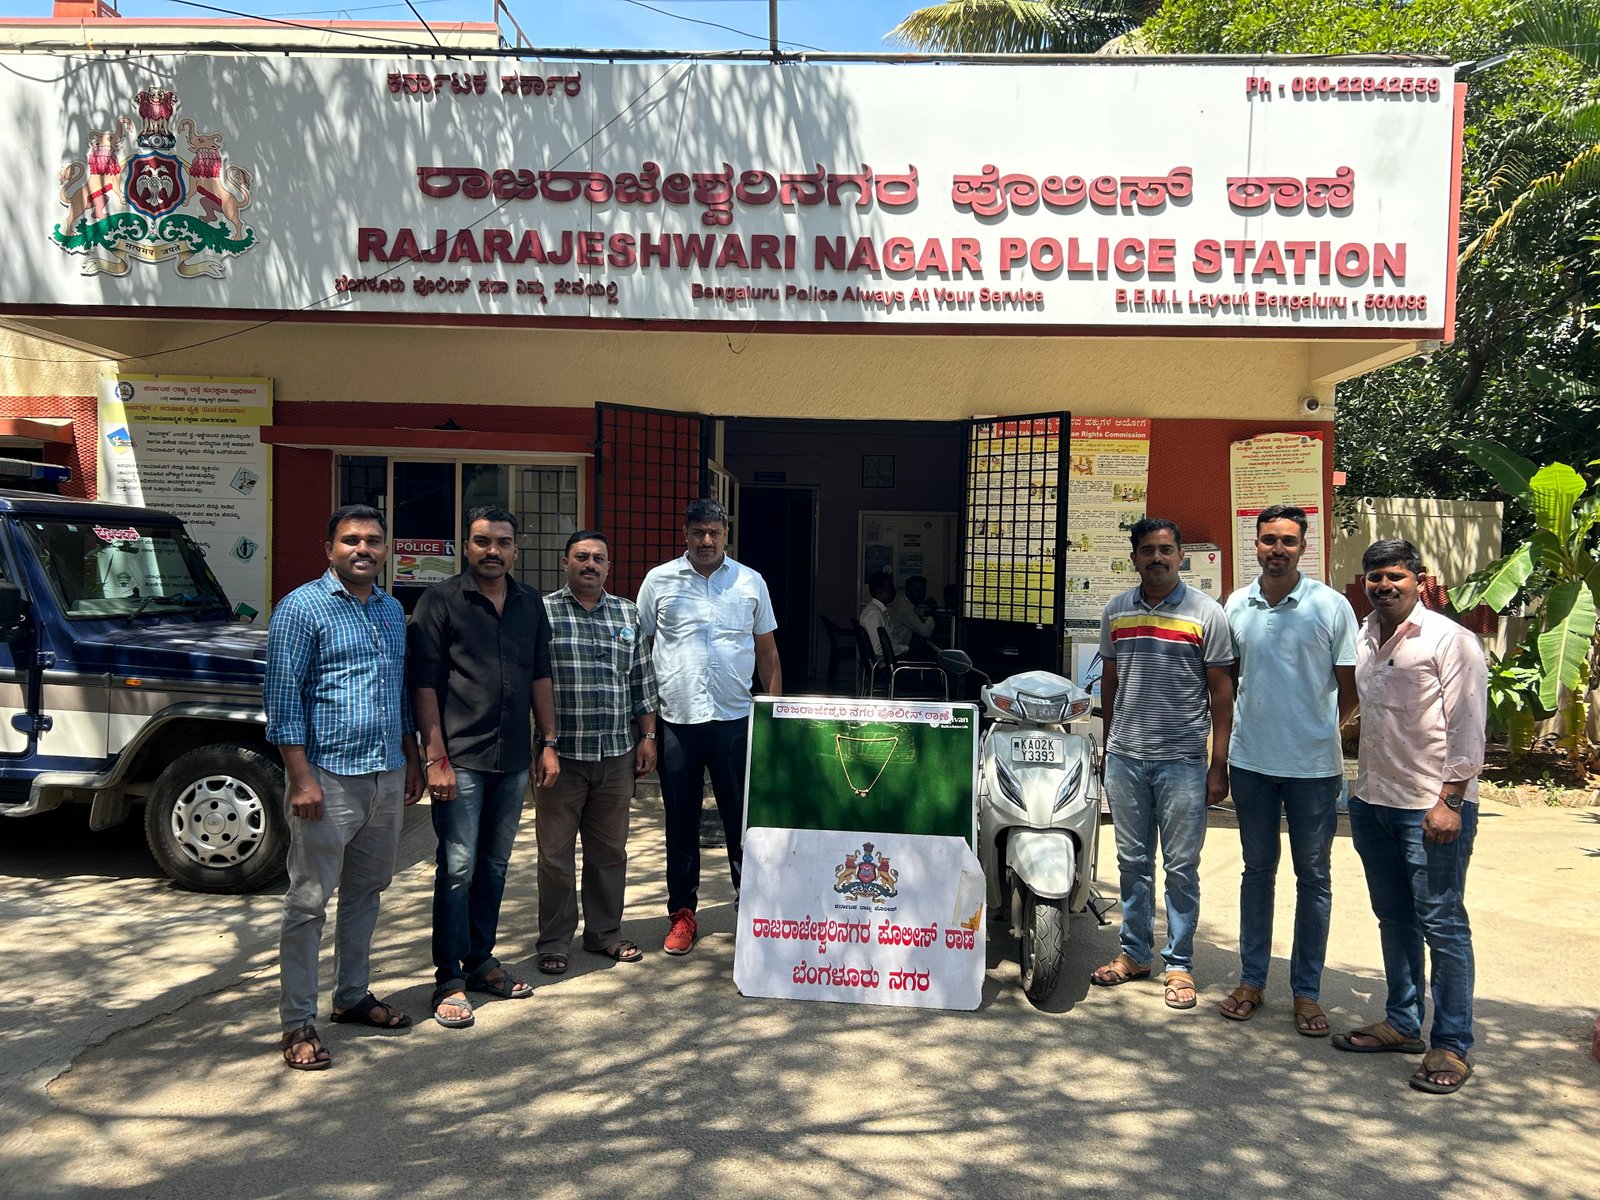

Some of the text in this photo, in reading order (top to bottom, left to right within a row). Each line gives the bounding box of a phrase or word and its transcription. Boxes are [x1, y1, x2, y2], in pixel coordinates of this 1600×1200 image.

[387, 68, 581, 98] ಕರ್ನಾಟಕ ಸರ್ಕಾರ
[1246, 77, 1271, 93] Ph
[1292, 76, 1440, 94] 080-22942559
[416, 162, 1355, 226] ರಾಜರಾಜೇಶ್ವರಿನಗರ ಪೊಲೀಸ್ ಠಾಣೆ
[125, 243, 180, 255] सत्यमेव जयते
[358, 227, 1407, 281] RAJARAJESHWARI NAGAR POLICE STATION
[335, 275, 405, 295] ಬೆಂಗಳೂರು
[478, 278, 509, 295] ಸದಾ
[516, 278, 548, 304] ನಿಮ್ಮ
[555, 278, 619, 305] ಸೇವೆಯಲ್ಲಿ
[691, 283, 1043, 306] Bengaluru Police Always At Your Service
[1188, 290, 1249, 309] Layout
[1255, 291, 1347, 310] Bengaluru
[1364, 294, 1427, 310] 560098
[1114, 418, 1146, 427] ಆಯೋಗ
[1081, 431, 1103, 439] Rights
[396, 542, 440, 552] POLICE
[849, 706, 875, 718] ನಗರ
[878, 707, 922, 721] ಪೊಲೀಸ್
[924, 710, 950, 721] ಠಾಣೆ
[1021, 739, 1054, 751] KA02K
[1021, 750, 1055, 762] Y3393
[753, 915, 871, 954] ರಾಜರಾಜೇಶ್ವರಿನಗರ
[878, 919, 938, 948] ಪೊಲೀಸ್
[792, 960, 930, 991] ಬೆಂಗಳೂರು ನಗರ
